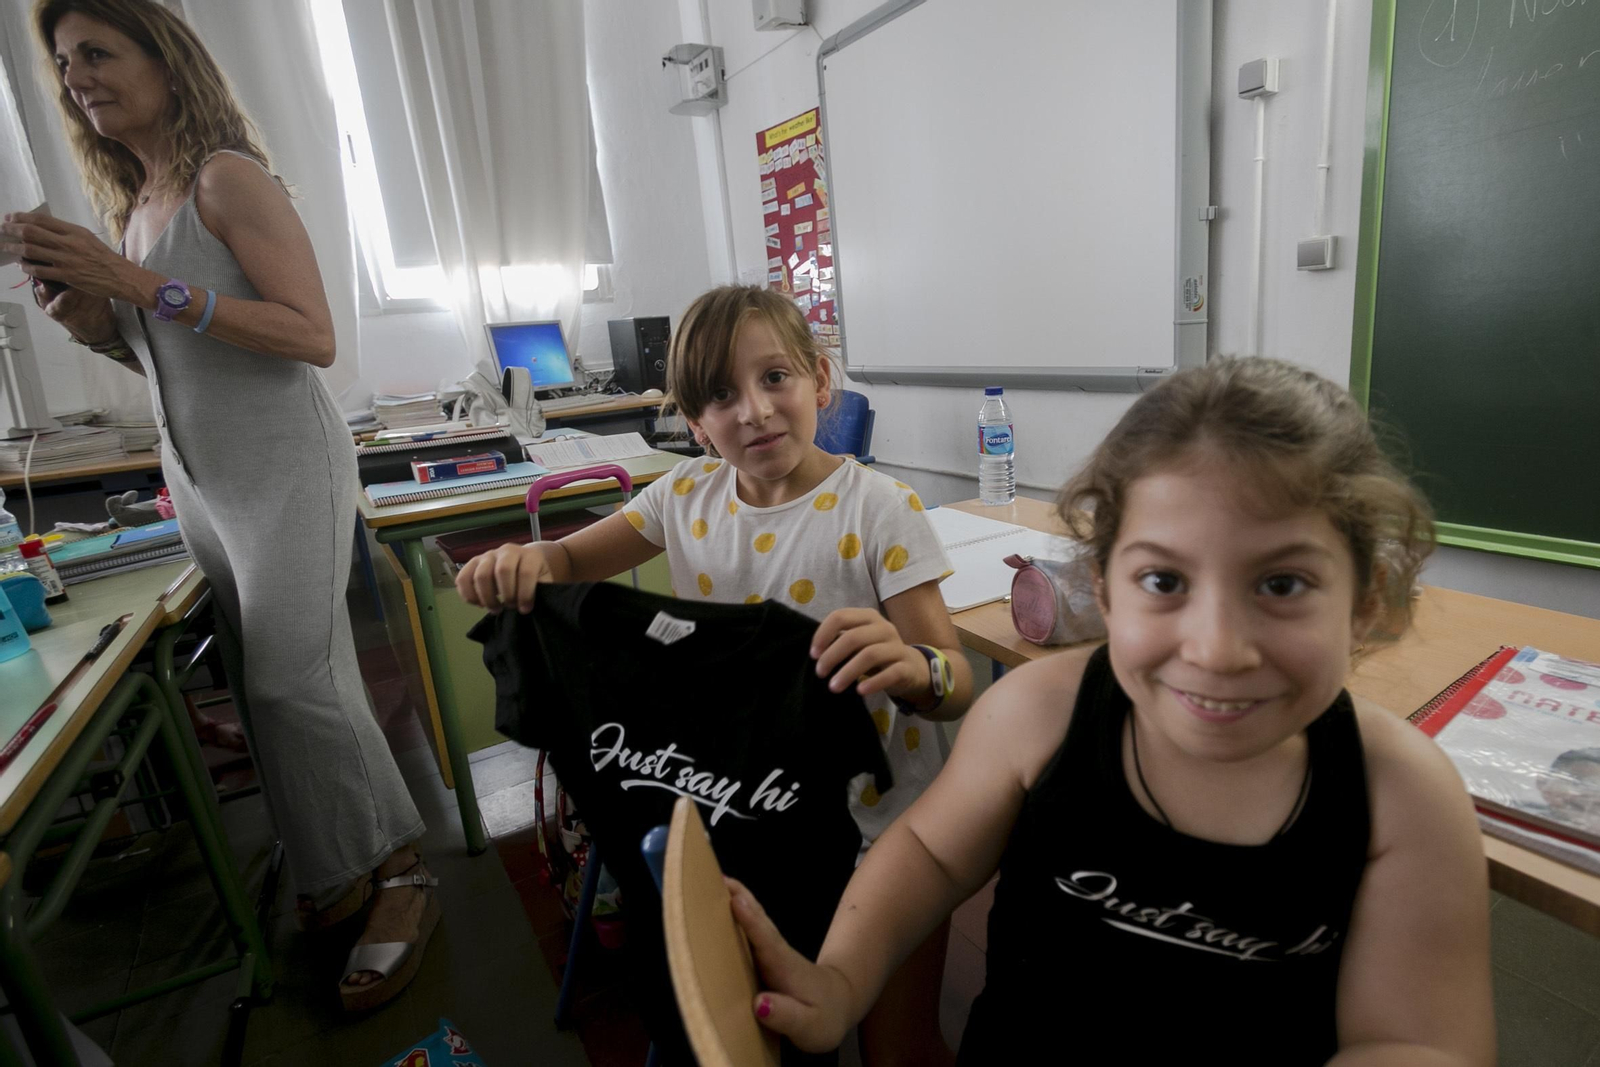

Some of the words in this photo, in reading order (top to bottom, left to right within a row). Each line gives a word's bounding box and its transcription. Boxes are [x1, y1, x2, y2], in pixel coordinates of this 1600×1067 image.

[590, 722, 695, 779] Just
[675, 766, 741, 826] say
[749, 768, 800, 812] hi
[1055, 871, 1214, 928] Just
[1185, 922, 1278, 960] say
[1285, 925, 1339, 954] hi
